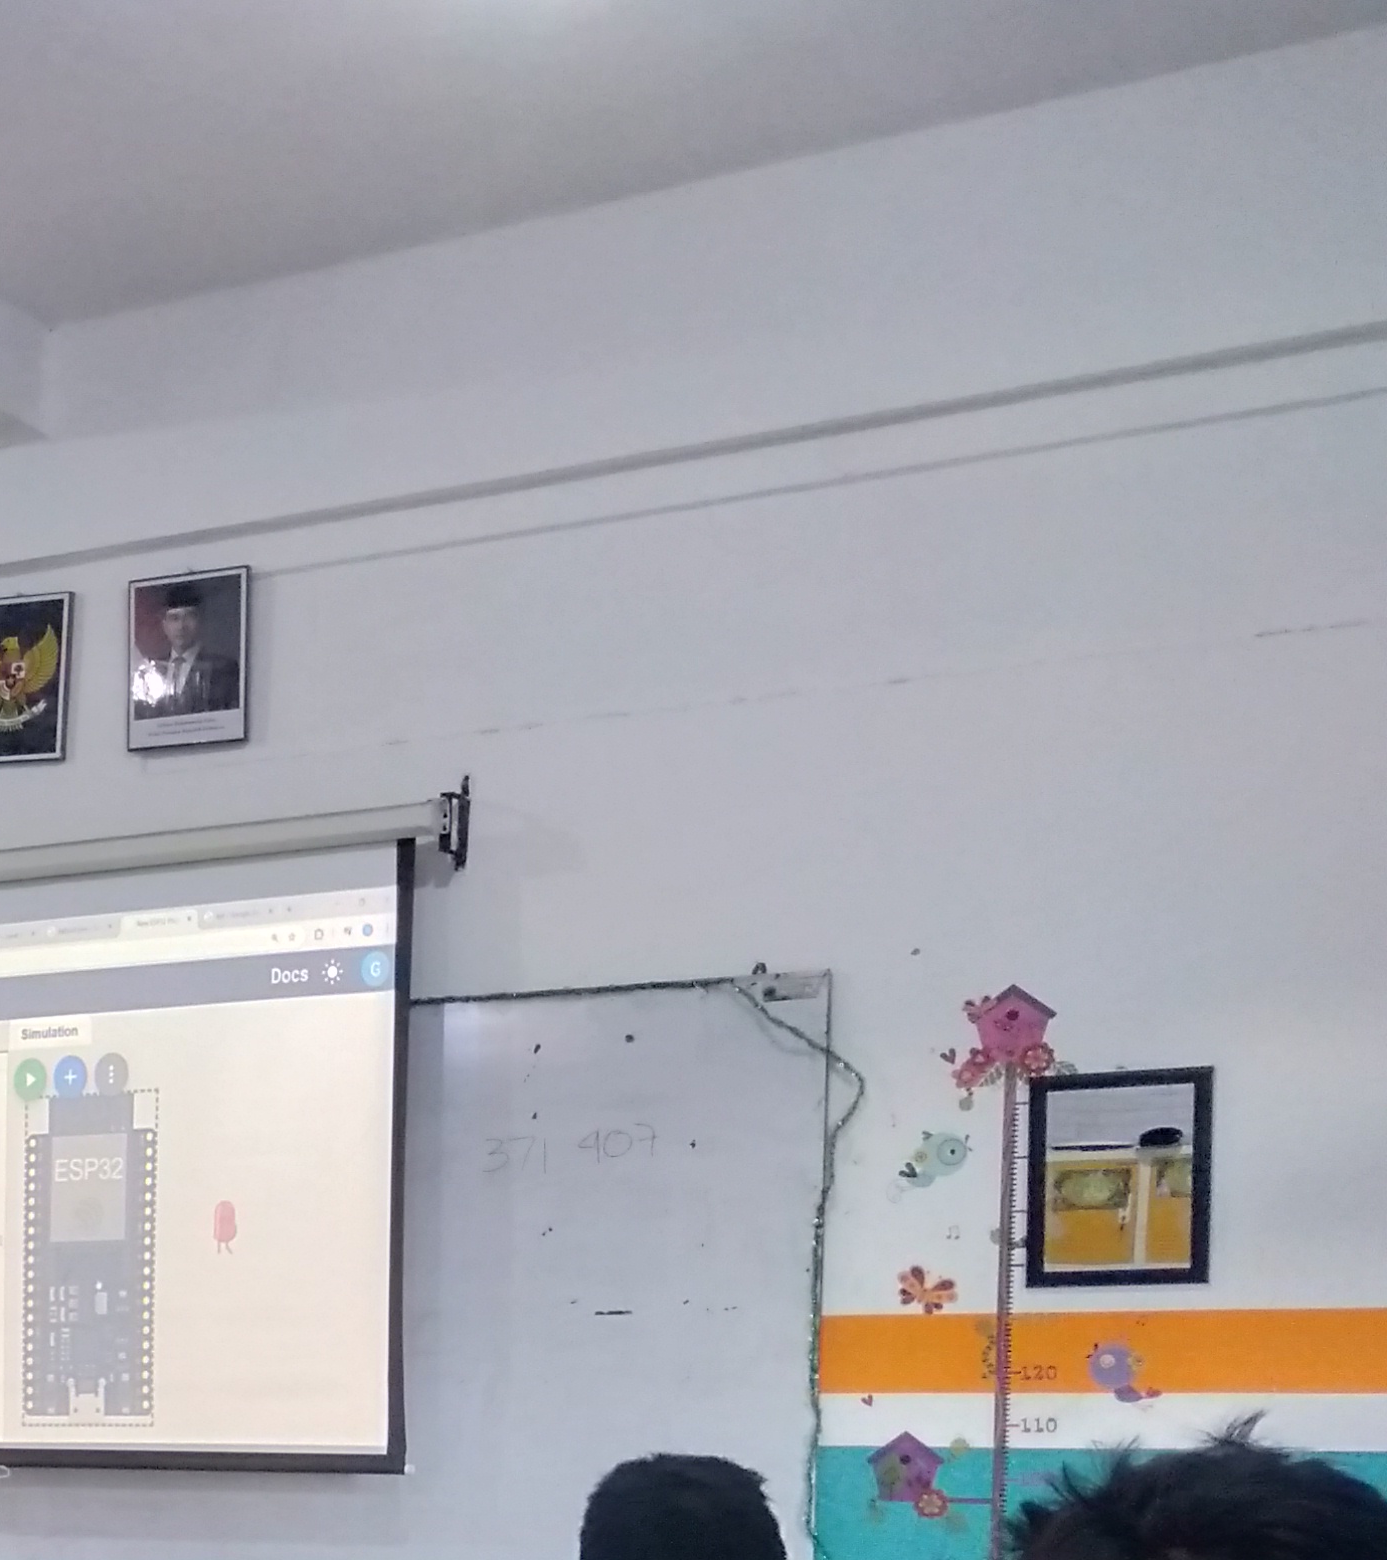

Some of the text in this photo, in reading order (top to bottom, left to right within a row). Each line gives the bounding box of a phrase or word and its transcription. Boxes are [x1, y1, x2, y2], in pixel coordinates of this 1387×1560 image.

[271, 967, 309, 984] Docs
[21, 1025, 79, 1041] Simulation
[481, 1122, 659, 1175] 371 407
[54, 1157, 124, 1183] ESP32
[1021, 1366, 1058, 1381] 120
[1021, 1417, 1058, 1433] 110
